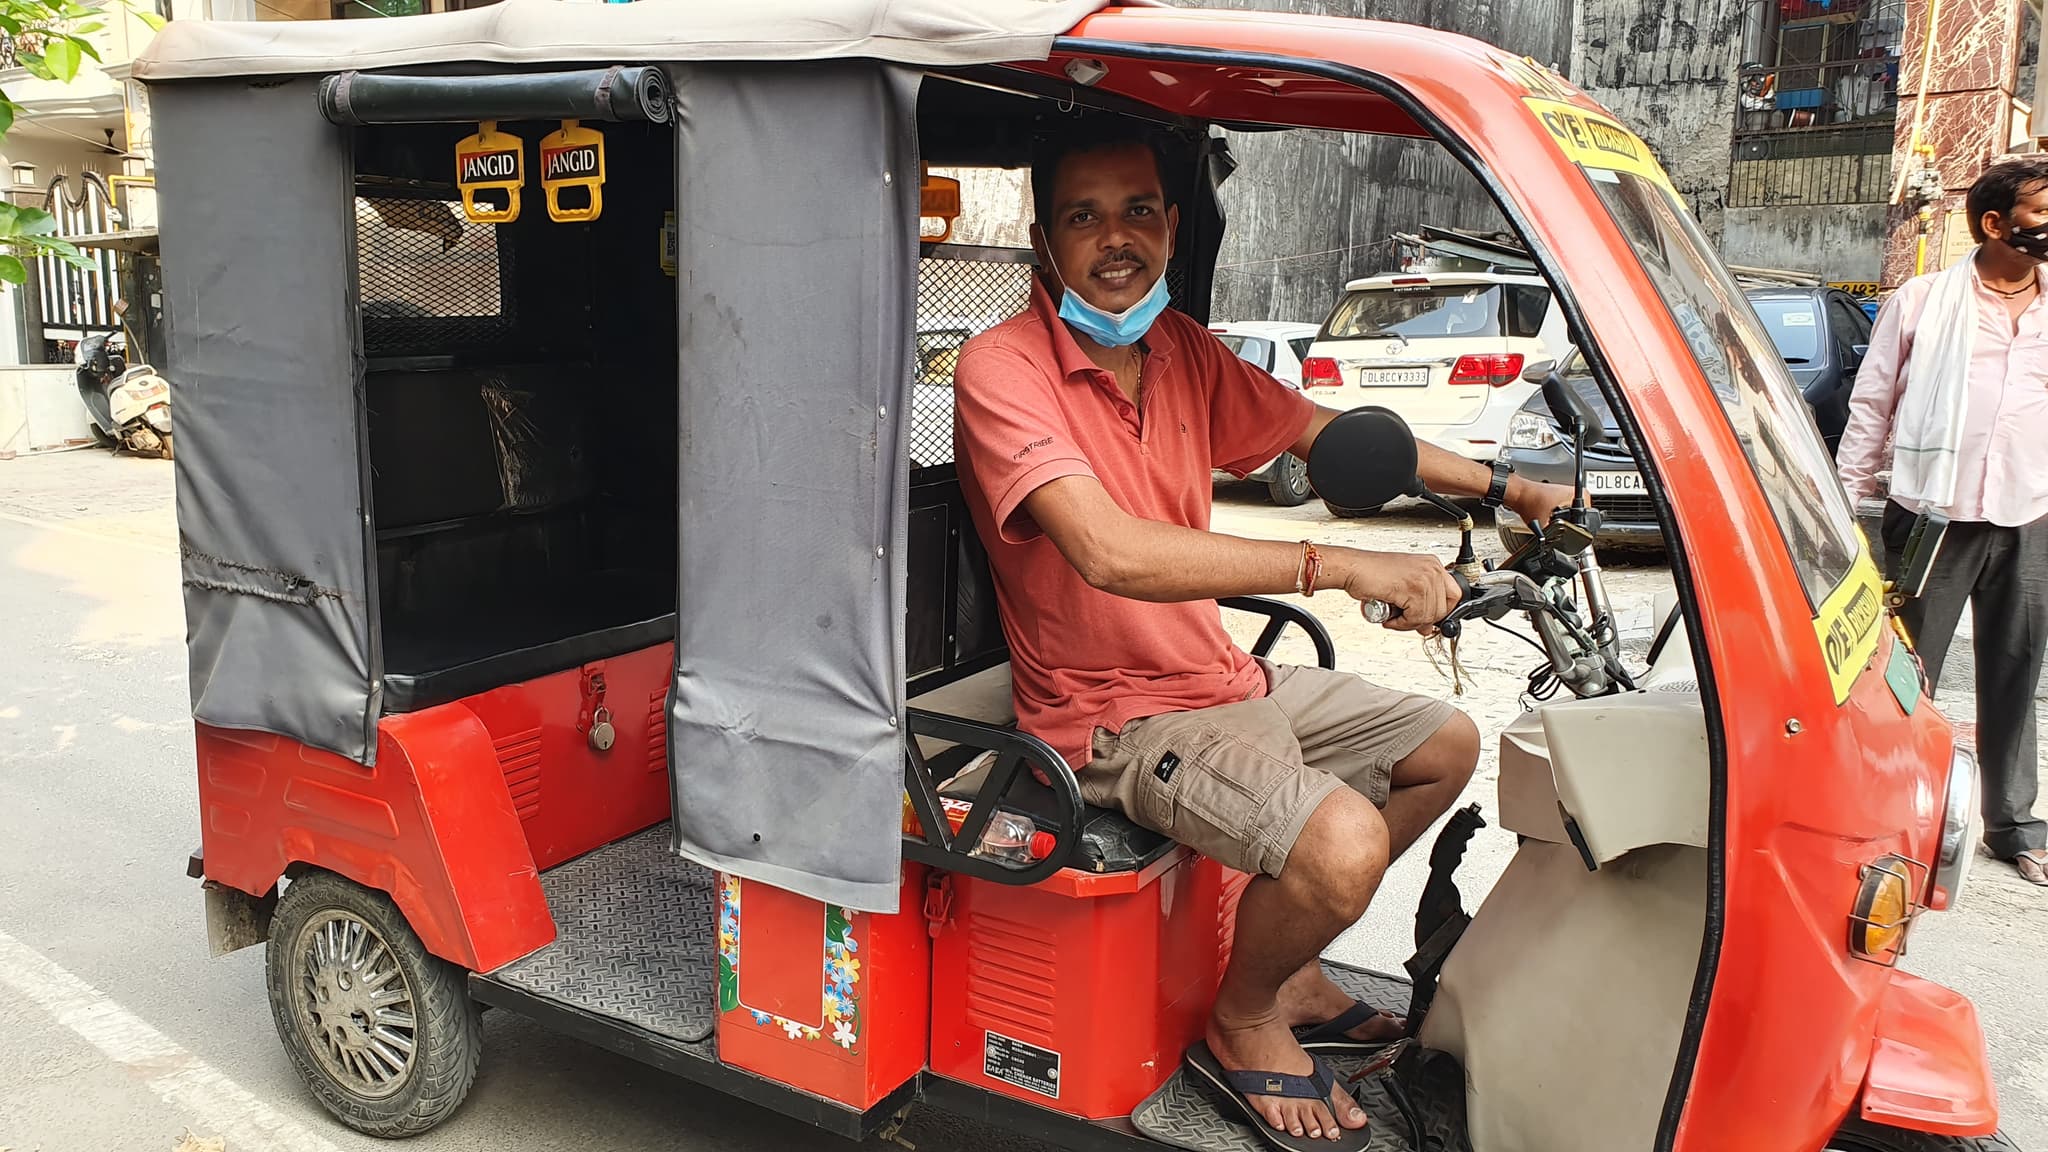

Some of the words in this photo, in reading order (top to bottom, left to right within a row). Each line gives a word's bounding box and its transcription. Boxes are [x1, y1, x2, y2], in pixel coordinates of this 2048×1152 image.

[463, 154, 515, 182] JANGID
[547, 149, 595, 179] JANGID
[1367, 371, 1426, 383] DL8CCV3333
[1596, 475, 1646, 489] DL8CA
